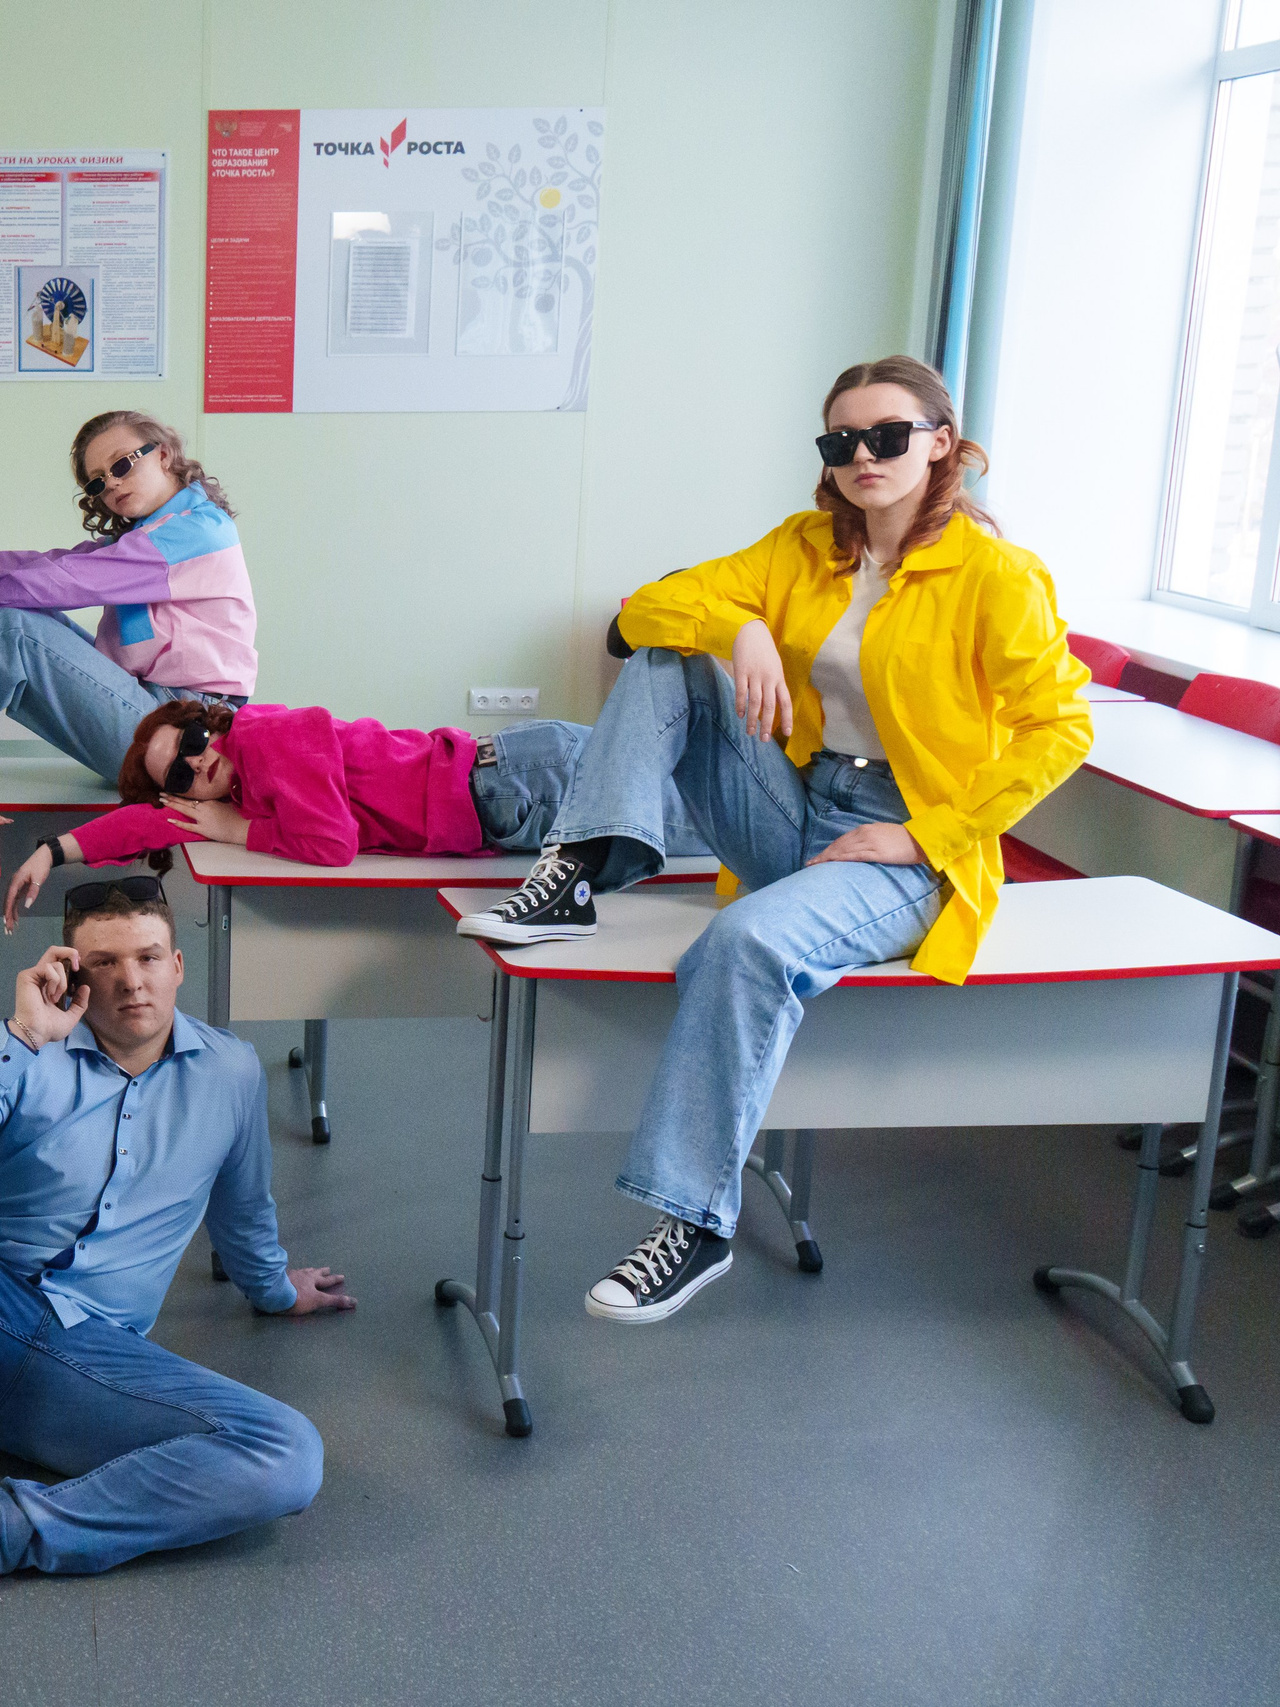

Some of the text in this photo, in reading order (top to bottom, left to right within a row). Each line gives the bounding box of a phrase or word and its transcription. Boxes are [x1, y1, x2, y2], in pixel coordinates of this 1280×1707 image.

[313, 140, 465, 156] ТОЧКА РОСТА
[212, 148, 279, 158] ЧТО ТАКОЕ ЦЕНТР
[37, 156, 76, 164] УРОКАХ
[80, 156, 124, 164] ФИЗИКИ
[212, 159, 268, 167] ОБРАЗОВАНИЯ
[212, 169, 275, 178] «ТОЧКА РОСТА»?
